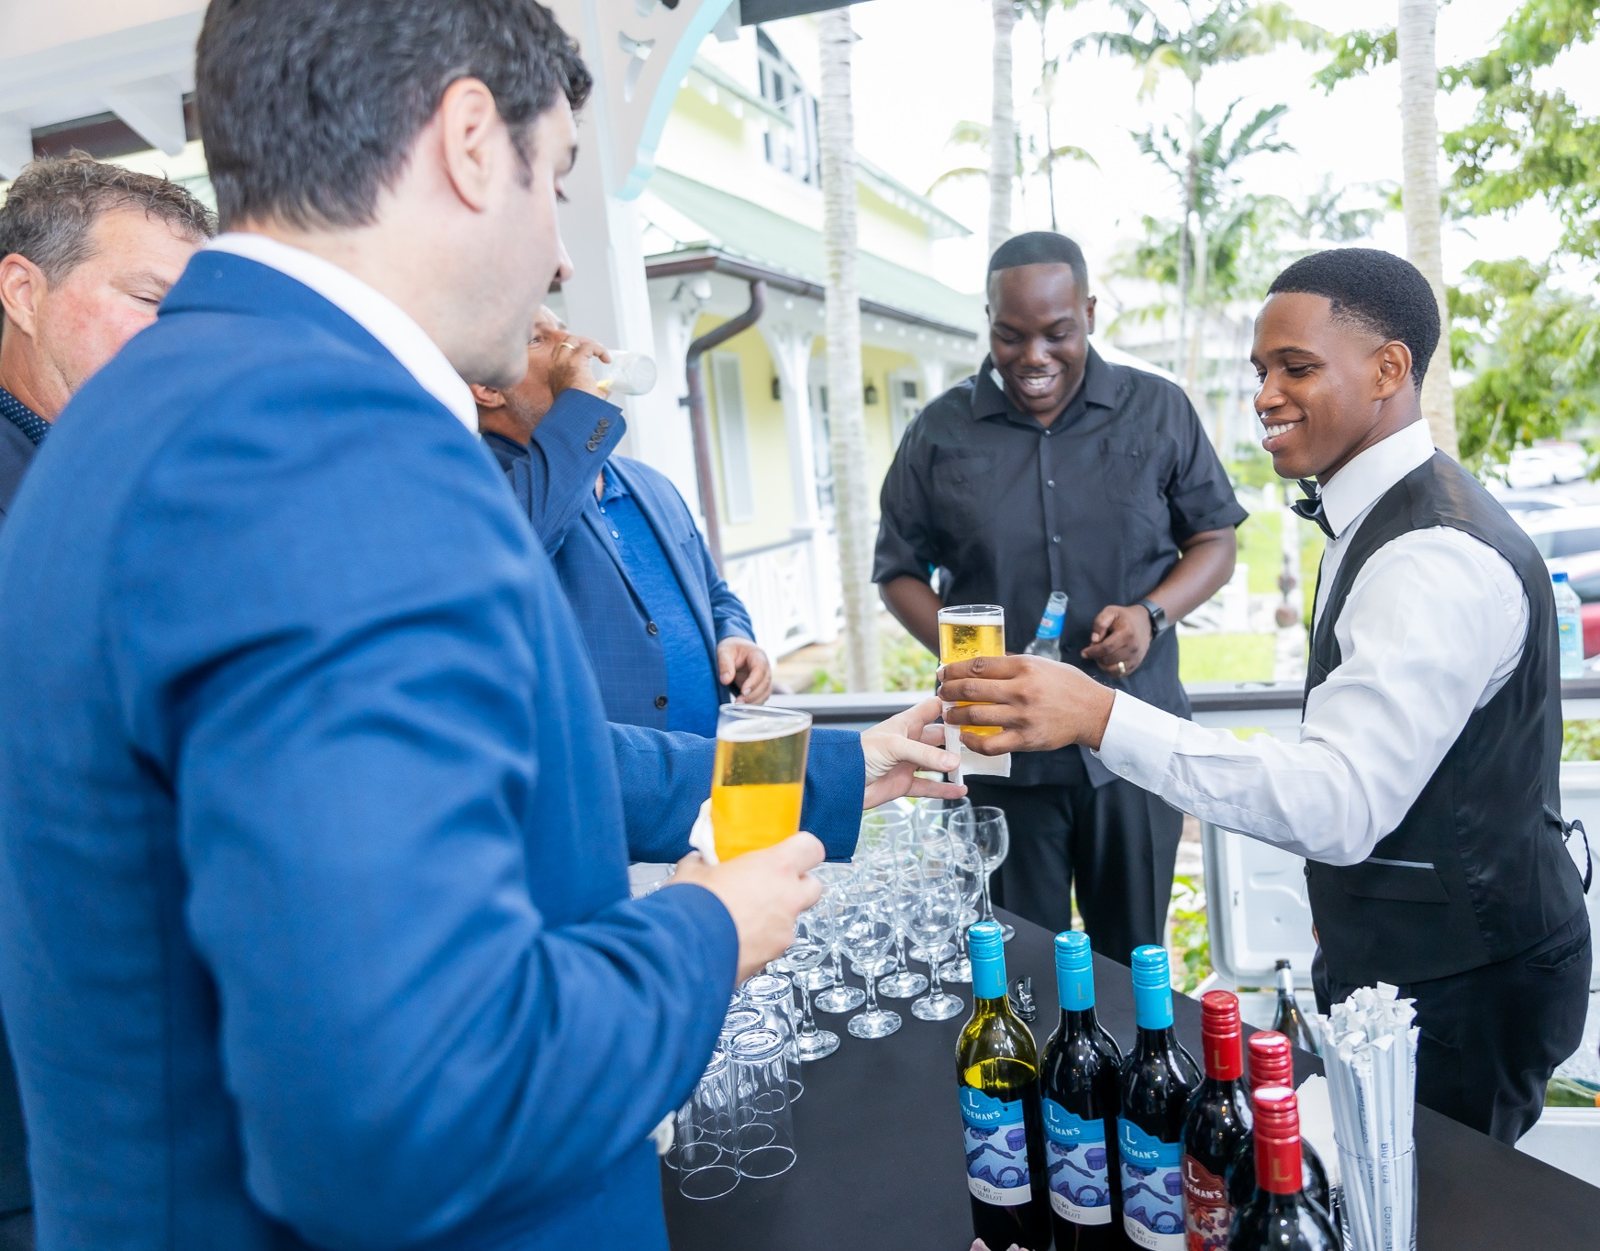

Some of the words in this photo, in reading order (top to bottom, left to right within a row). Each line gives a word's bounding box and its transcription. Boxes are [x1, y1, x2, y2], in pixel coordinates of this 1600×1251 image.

[1213, 1050, 1230, 1070] L
[967, 1090, 980, 1109] L
[961, 1103, 1001, 1121] NDEMAN'S
[1048, 1104, 1060, 1123] L
[1126, 1125, 1137, 1145] L
[1187, 1161, 1200, 1183] L
[1271, 1157, 1294, 1182] L
